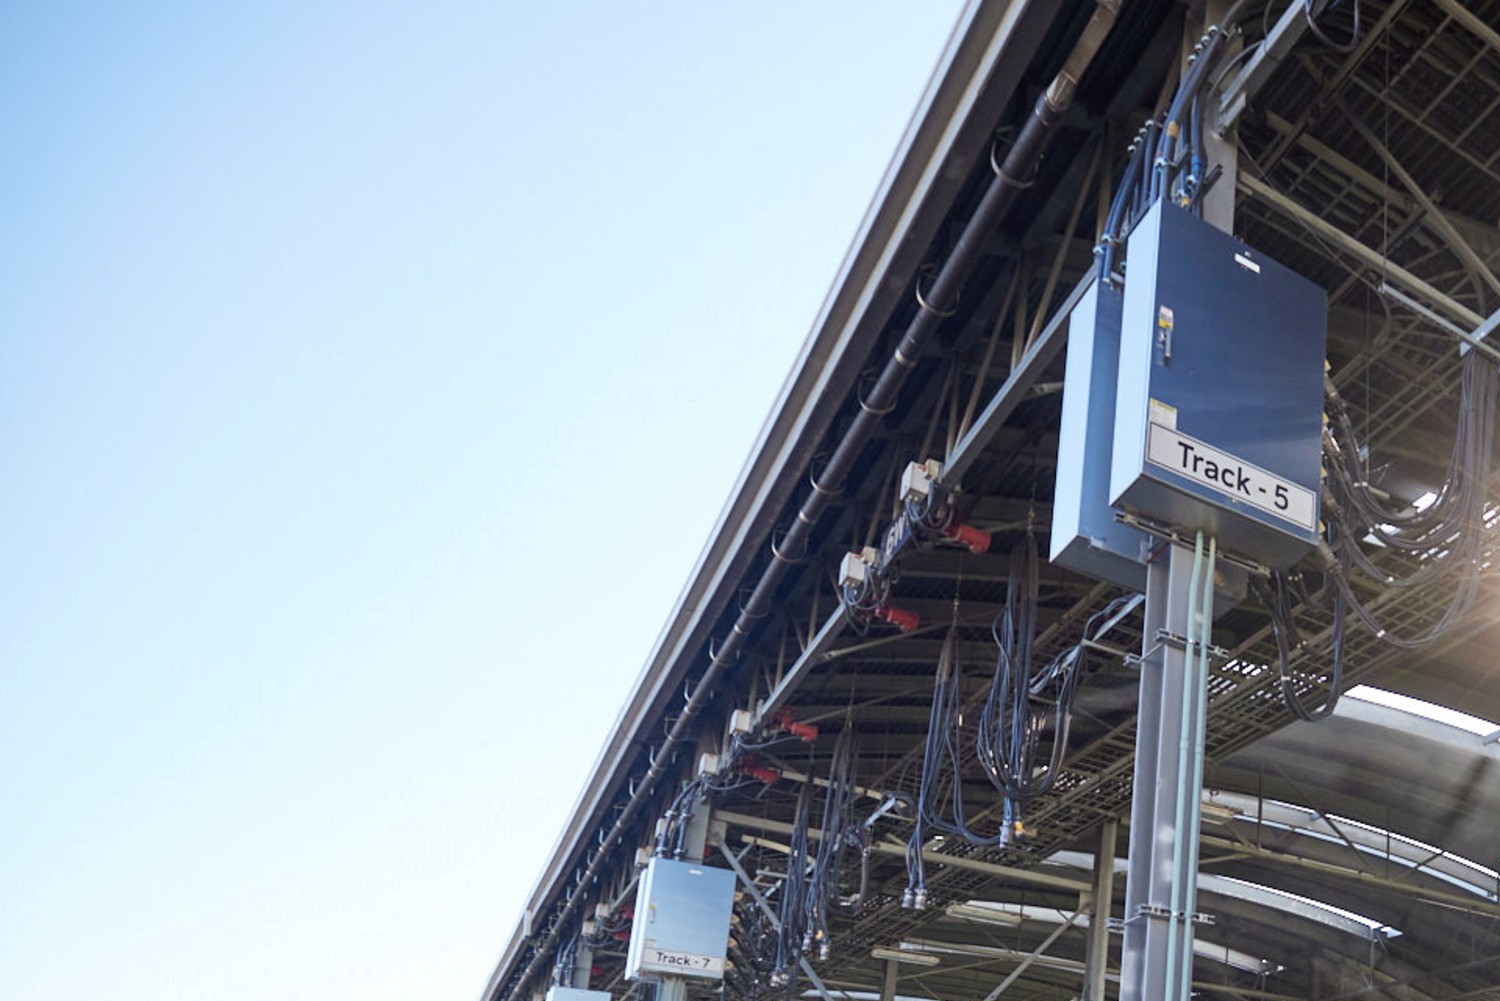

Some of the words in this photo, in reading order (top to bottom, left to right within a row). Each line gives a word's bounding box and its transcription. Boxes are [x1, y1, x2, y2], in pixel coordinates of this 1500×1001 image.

[1177, 441, 1251, 496] Track
[1274, 484, 1289, 511] 5
[656, 951, 691, 966] Track
[702, 957, 711, 968] 7
